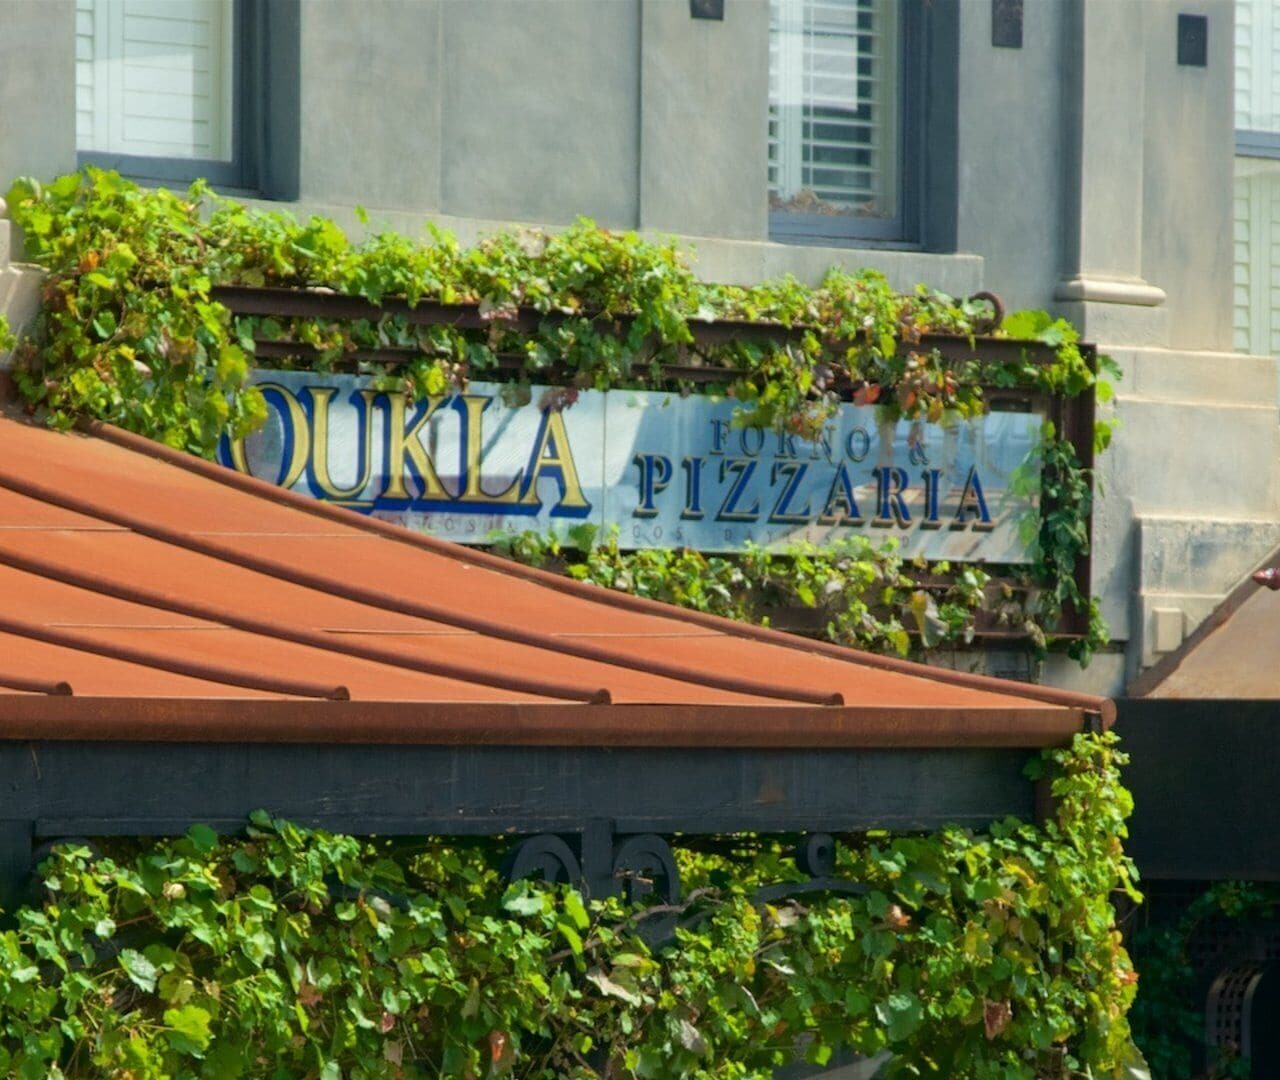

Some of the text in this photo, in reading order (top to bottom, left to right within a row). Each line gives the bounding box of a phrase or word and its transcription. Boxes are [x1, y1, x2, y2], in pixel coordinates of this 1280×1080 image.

[216, 382, 592, 518] OUKLA
[709, 419, 871, 464] FORNO
[632, 453, 998, 532] PIZZARIA
